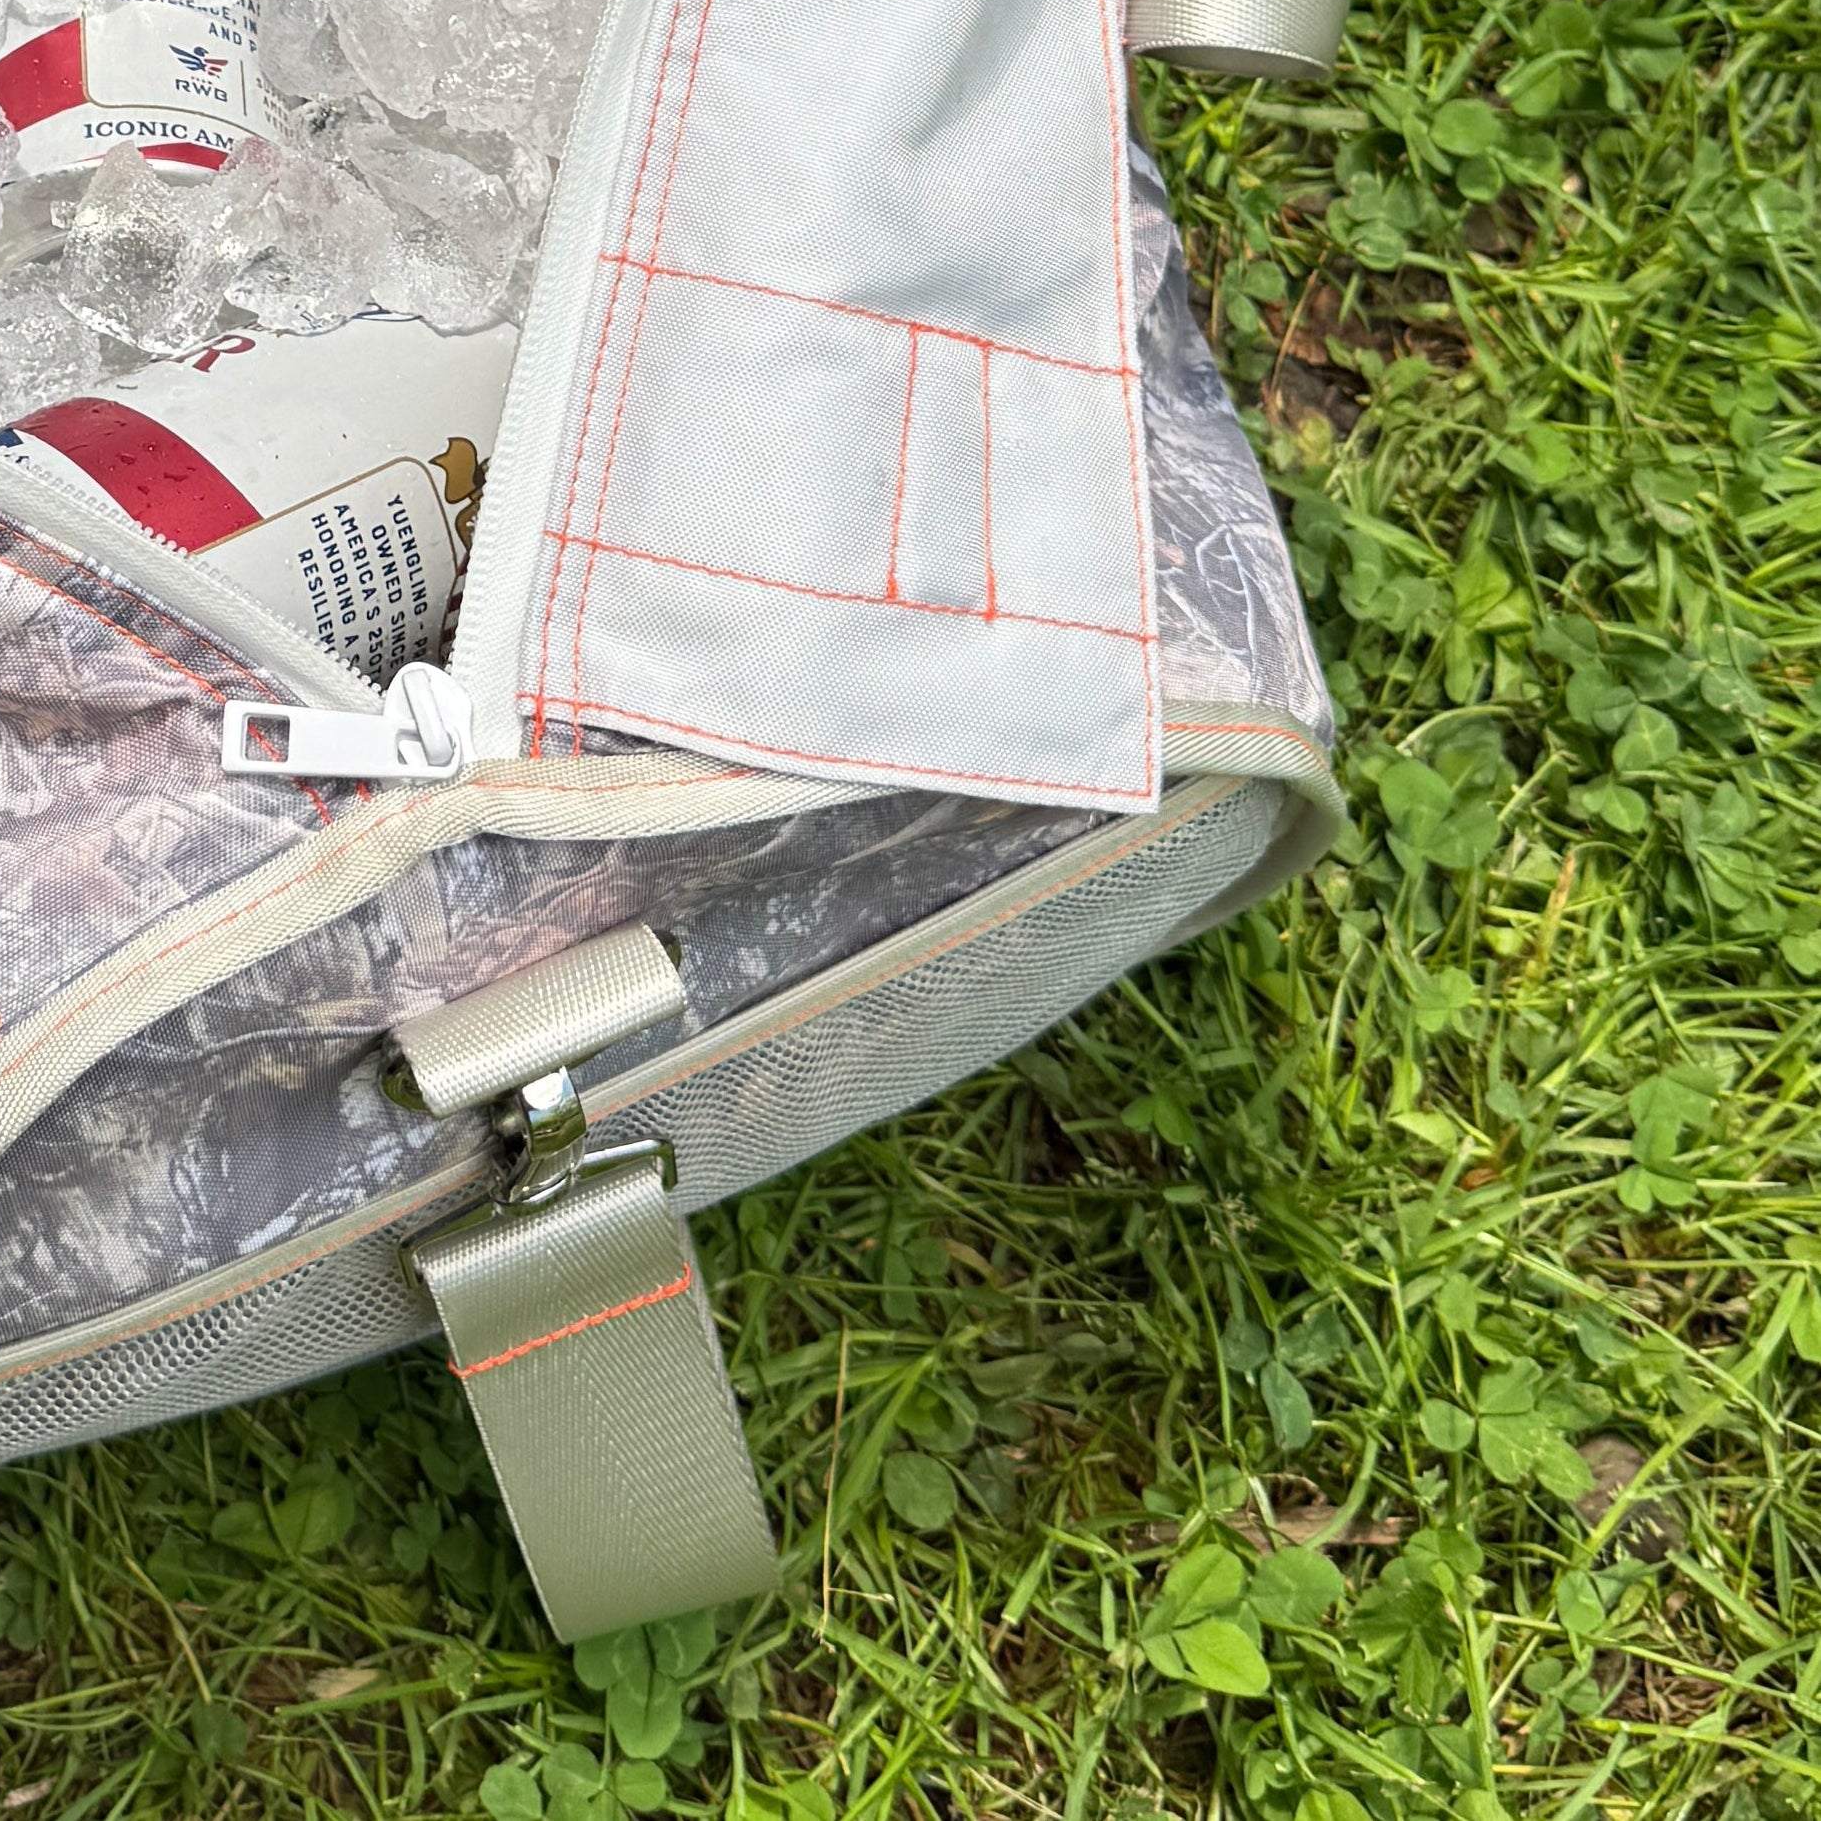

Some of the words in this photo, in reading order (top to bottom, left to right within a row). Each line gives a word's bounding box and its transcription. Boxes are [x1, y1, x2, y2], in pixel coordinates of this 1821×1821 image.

[174, 78, 229, 103] RWB
[208, 21, 243, 46] AND
[84, 121, 188, 140] ICONIC
[311, 513, 358, 626] HONORING
[344, 634, 359, 650] A
[334, 504, 382, 621] AMERICA'S
[367, 626, 383, 680] 250T
[371, 524, 404, 605] OWNED
[389, 612, 407, 669] SINCE
[387, 494, 429, 618] YUENGLING
